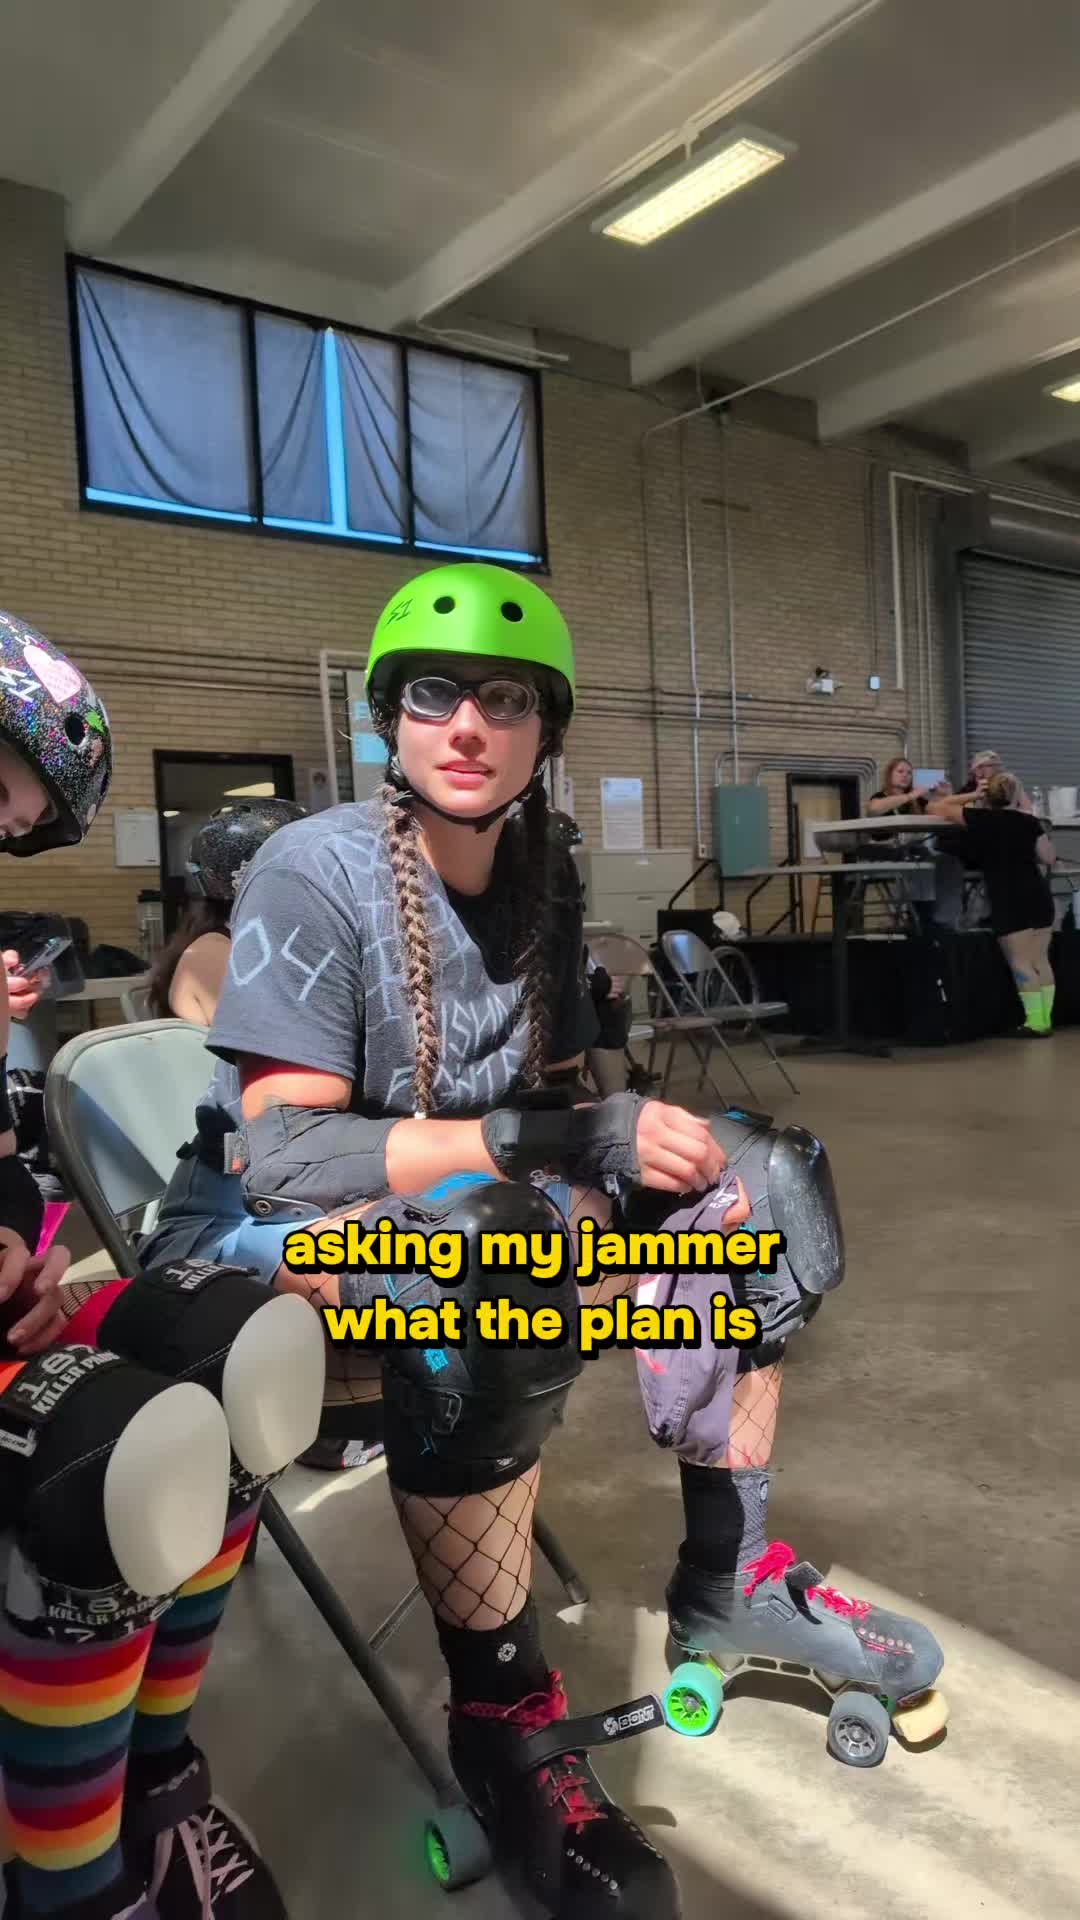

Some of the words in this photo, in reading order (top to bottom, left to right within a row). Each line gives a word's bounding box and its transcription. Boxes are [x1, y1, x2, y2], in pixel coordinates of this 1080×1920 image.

[31, 1366, 86, 1414] KILLER
[48, 1604, 109, 1626] KILLER
[618, 1704, 655, 1731] BONT
